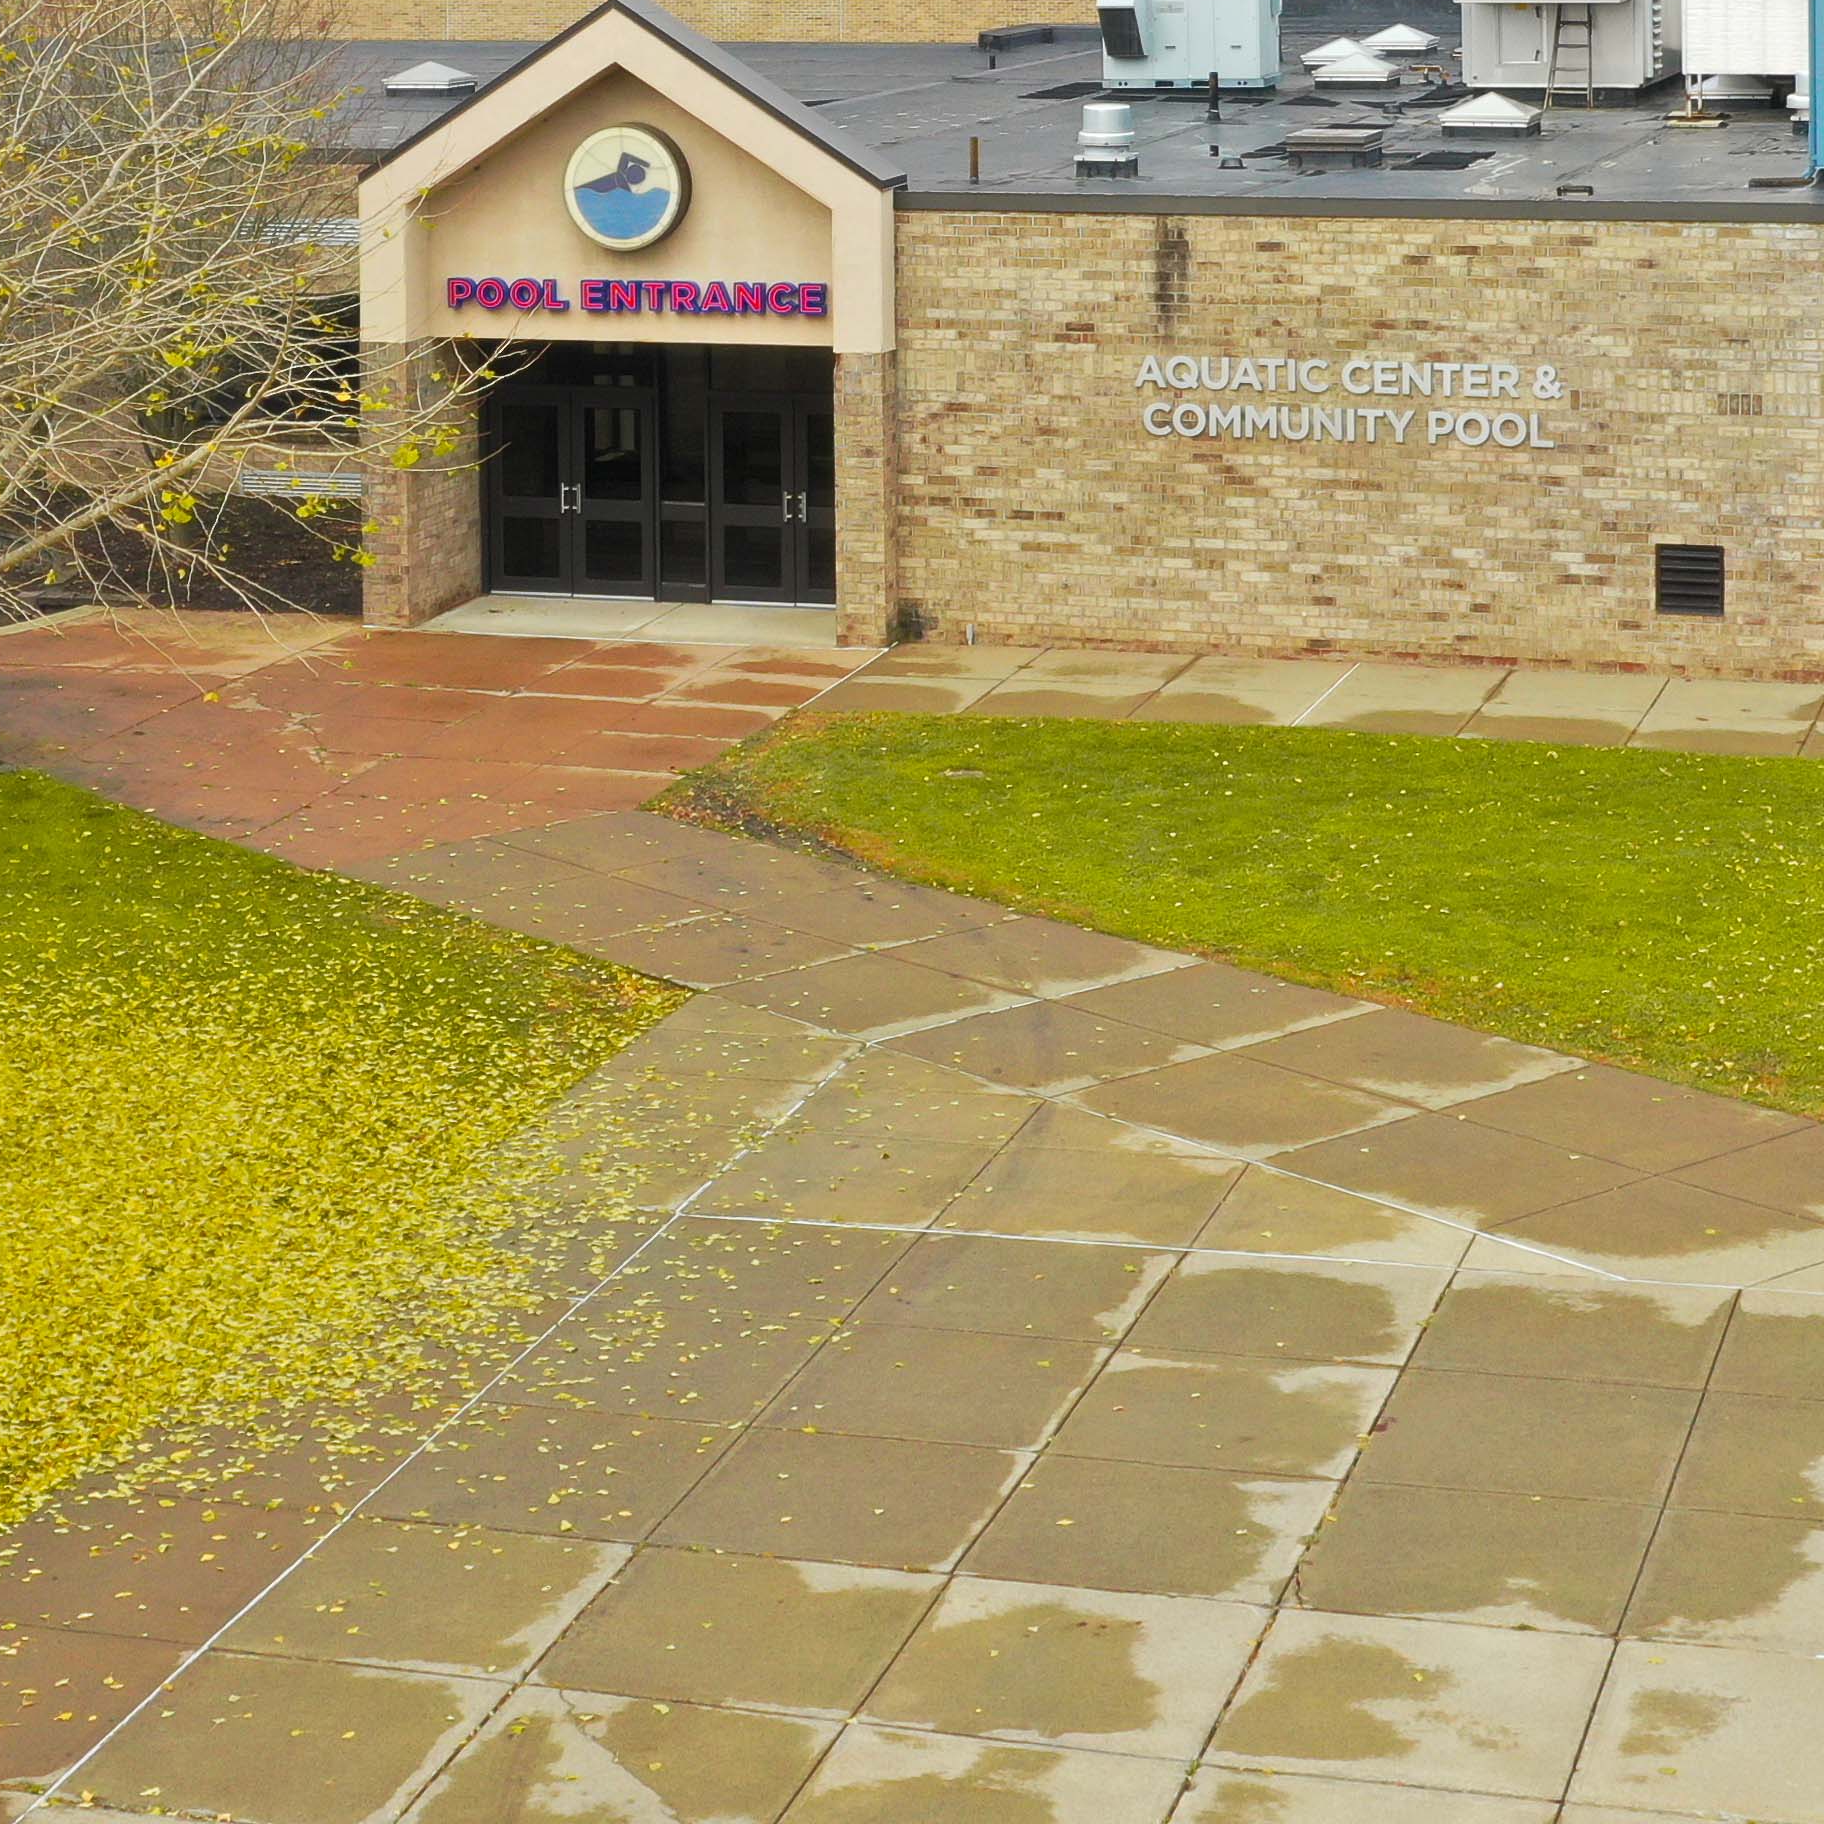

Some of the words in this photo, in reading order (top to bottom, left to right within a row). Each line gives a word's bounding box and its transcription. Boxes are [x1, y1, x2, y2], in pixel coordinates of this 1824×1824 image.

[447, 277, 570, 312] POOL
[579, 279, 828, 317] ENTRANCE
[1135, 355, 1329, 393] AQUATIC
[1341, 360, 1521, 398] CENTER
[1532, 364, 1564, 400] &
[1142, 402, 1416, 444] COMMUNITY
[1427, 410, 1556, 449] POOL
